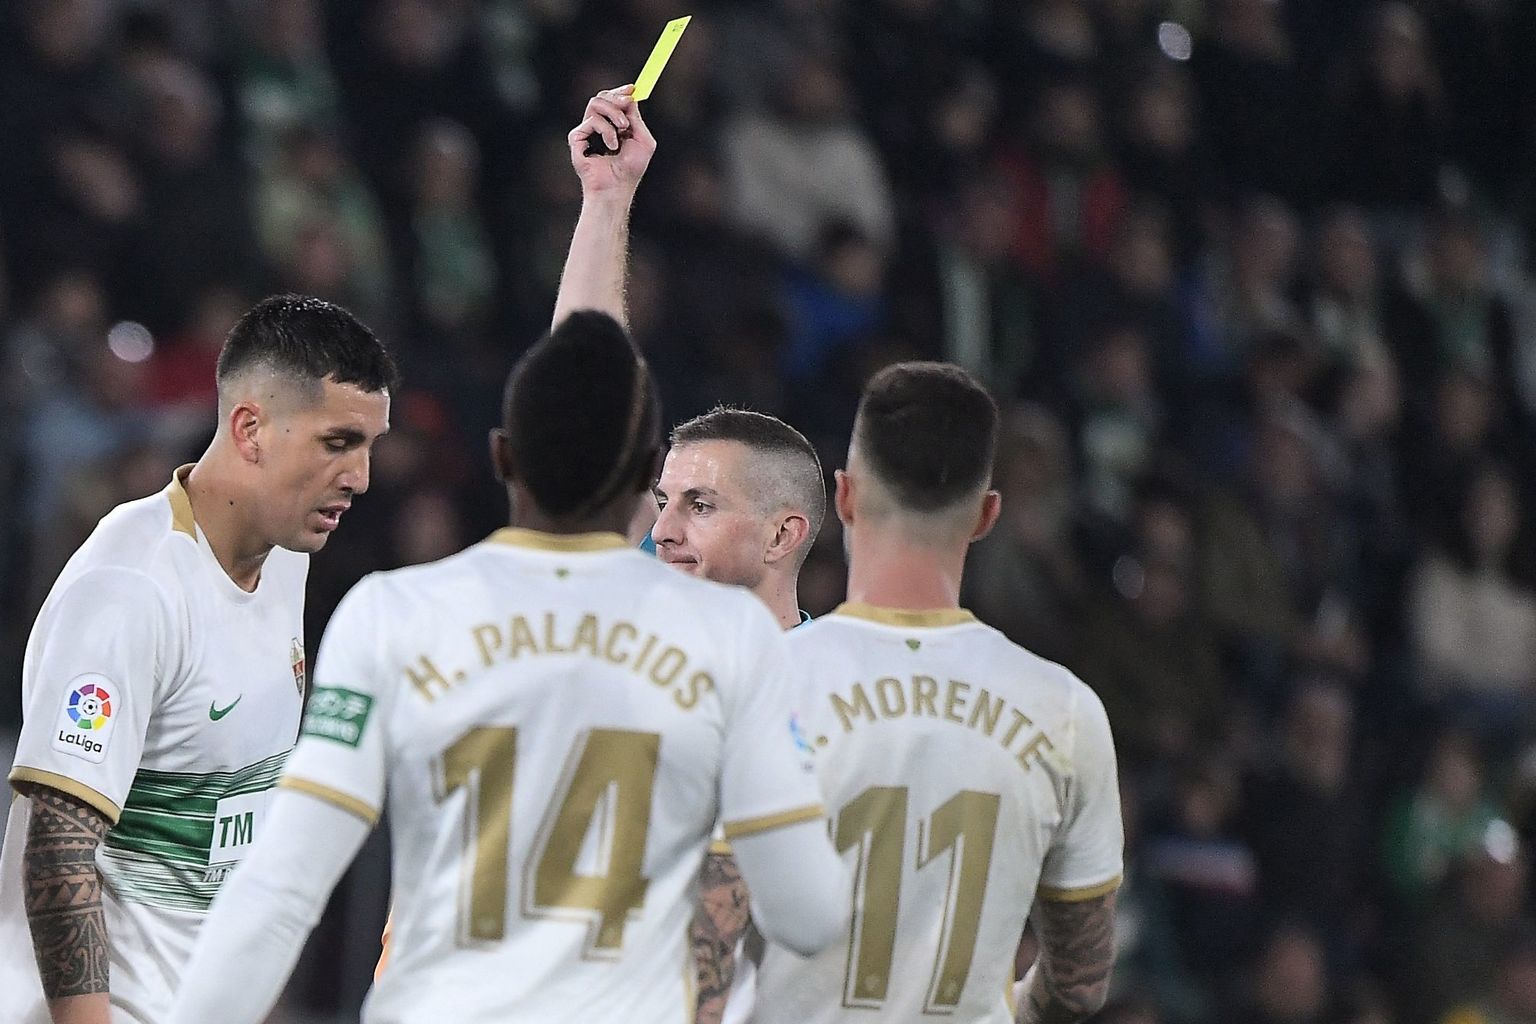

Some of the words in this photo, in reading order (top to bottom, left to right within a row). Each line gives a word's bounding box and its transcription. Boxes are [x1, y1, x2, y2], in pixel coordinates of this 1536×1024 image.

[404, 655, 467, 705] H.
[471, 612, 716, 712] PALACIOS
[58, 729, 103, 753] LaLiga
[830, 676, 1060, 774] MORENTE
[219, 811, 253, 848] TM
[430, 725, 661, 962] 14
[828, 784, 1002, 1015] 11
